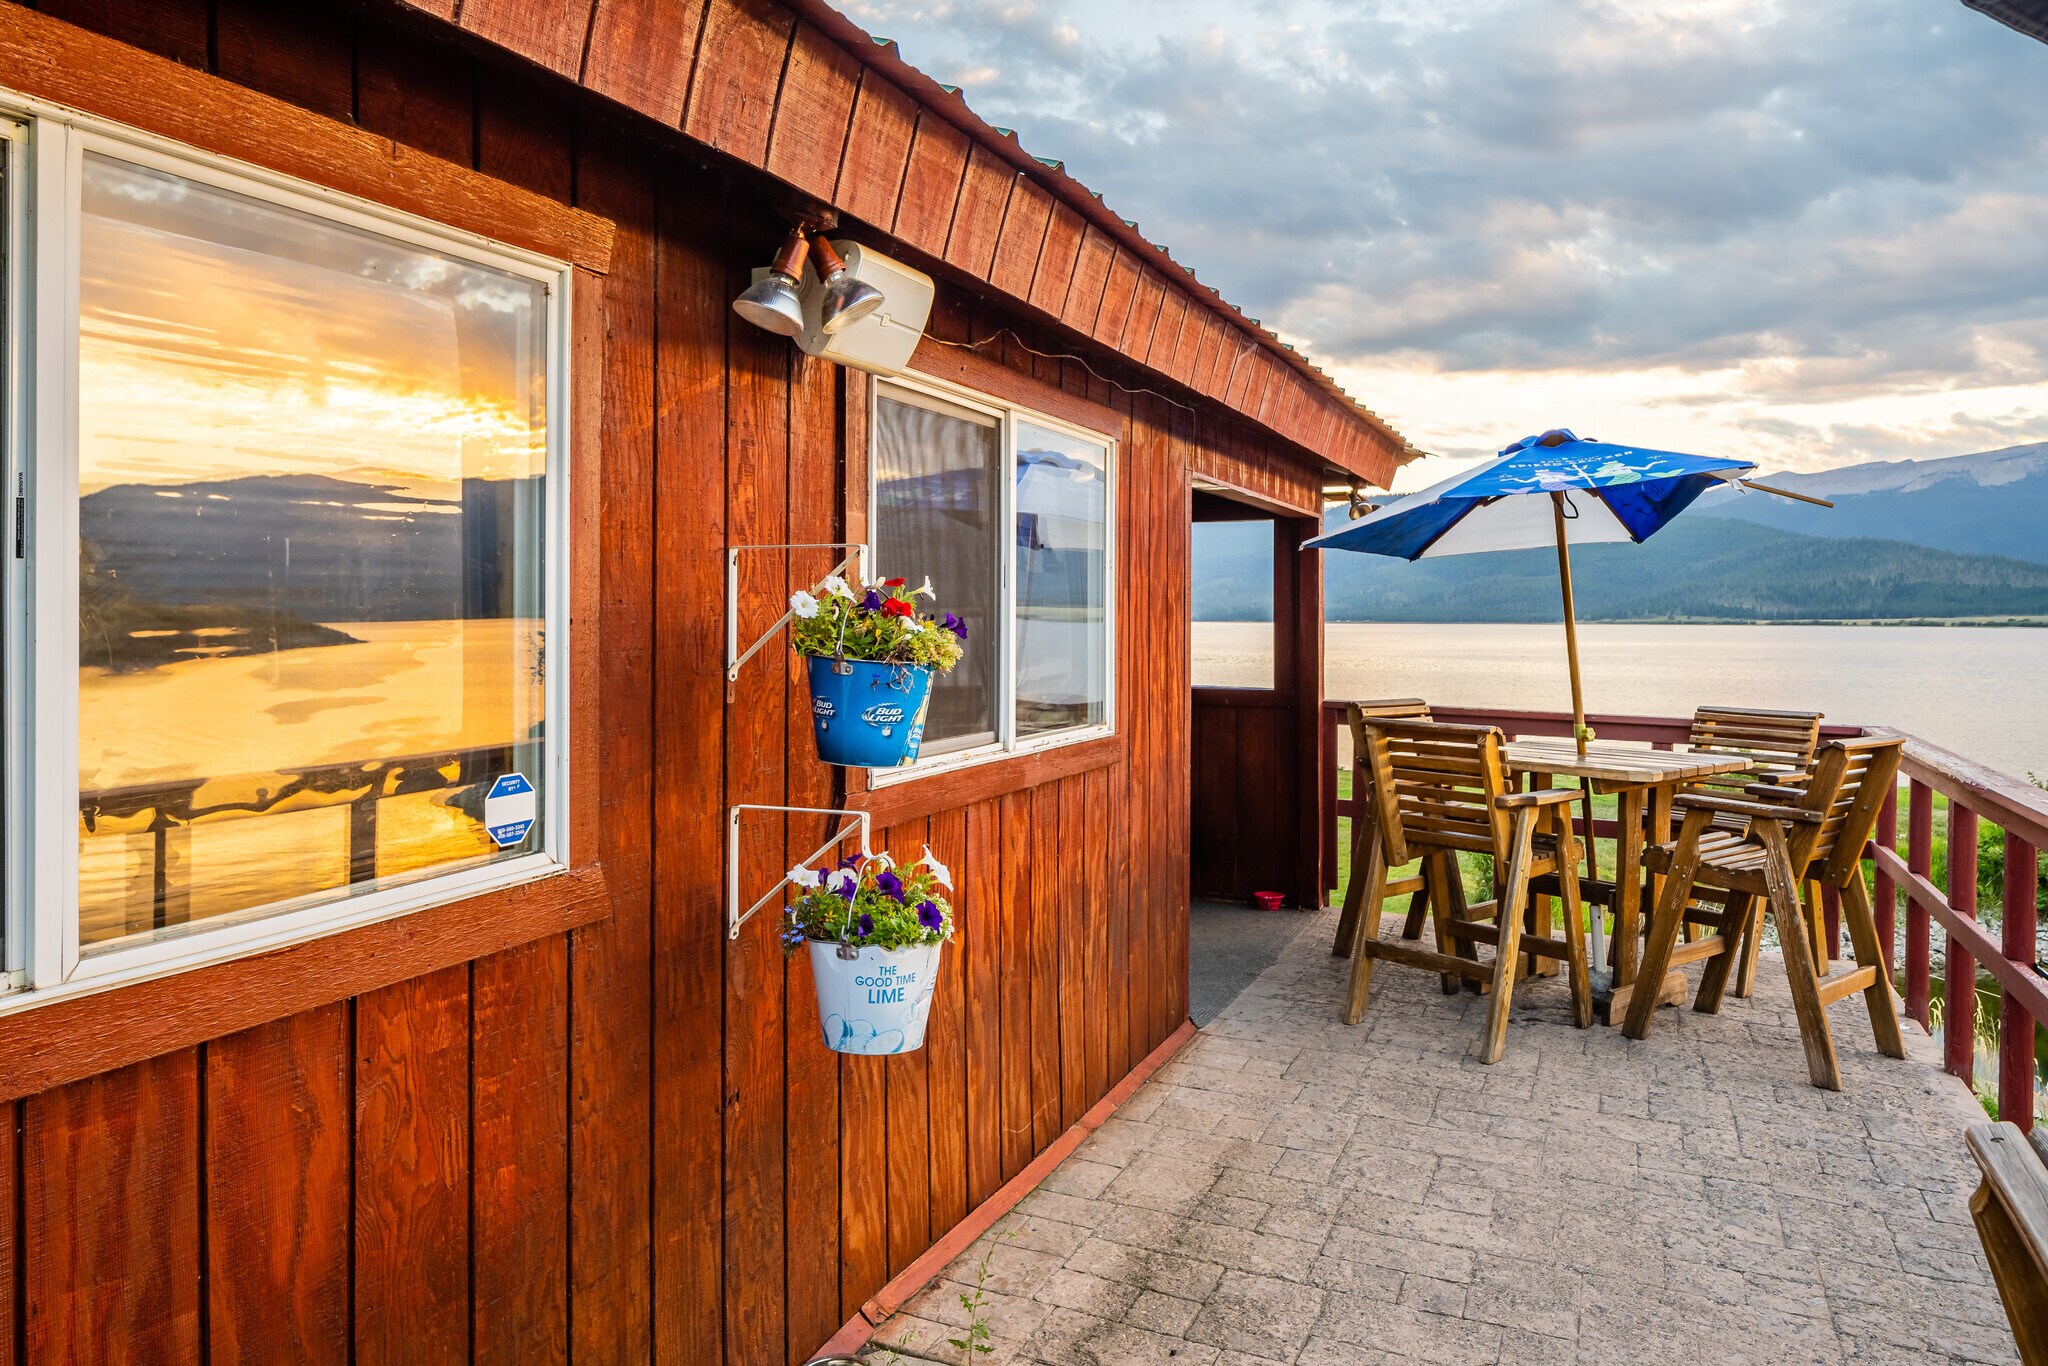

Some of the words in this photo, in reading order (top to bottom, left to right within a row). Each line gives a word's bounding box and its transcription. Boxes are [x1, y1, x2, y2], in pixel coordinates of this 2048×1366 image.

[816, 700, 833, 709] BUD
[814, 707, 836, 716] LIGHT
[875, 707, 902, 715] BUD
[869, 714, 905, 722] LIGHT
[501, 779, 520, 787] SECURITY
[879, 965, 897, 976] THE
[855, 975, 893, 987] GOOD
[895, 972, 916, 985] TIME
